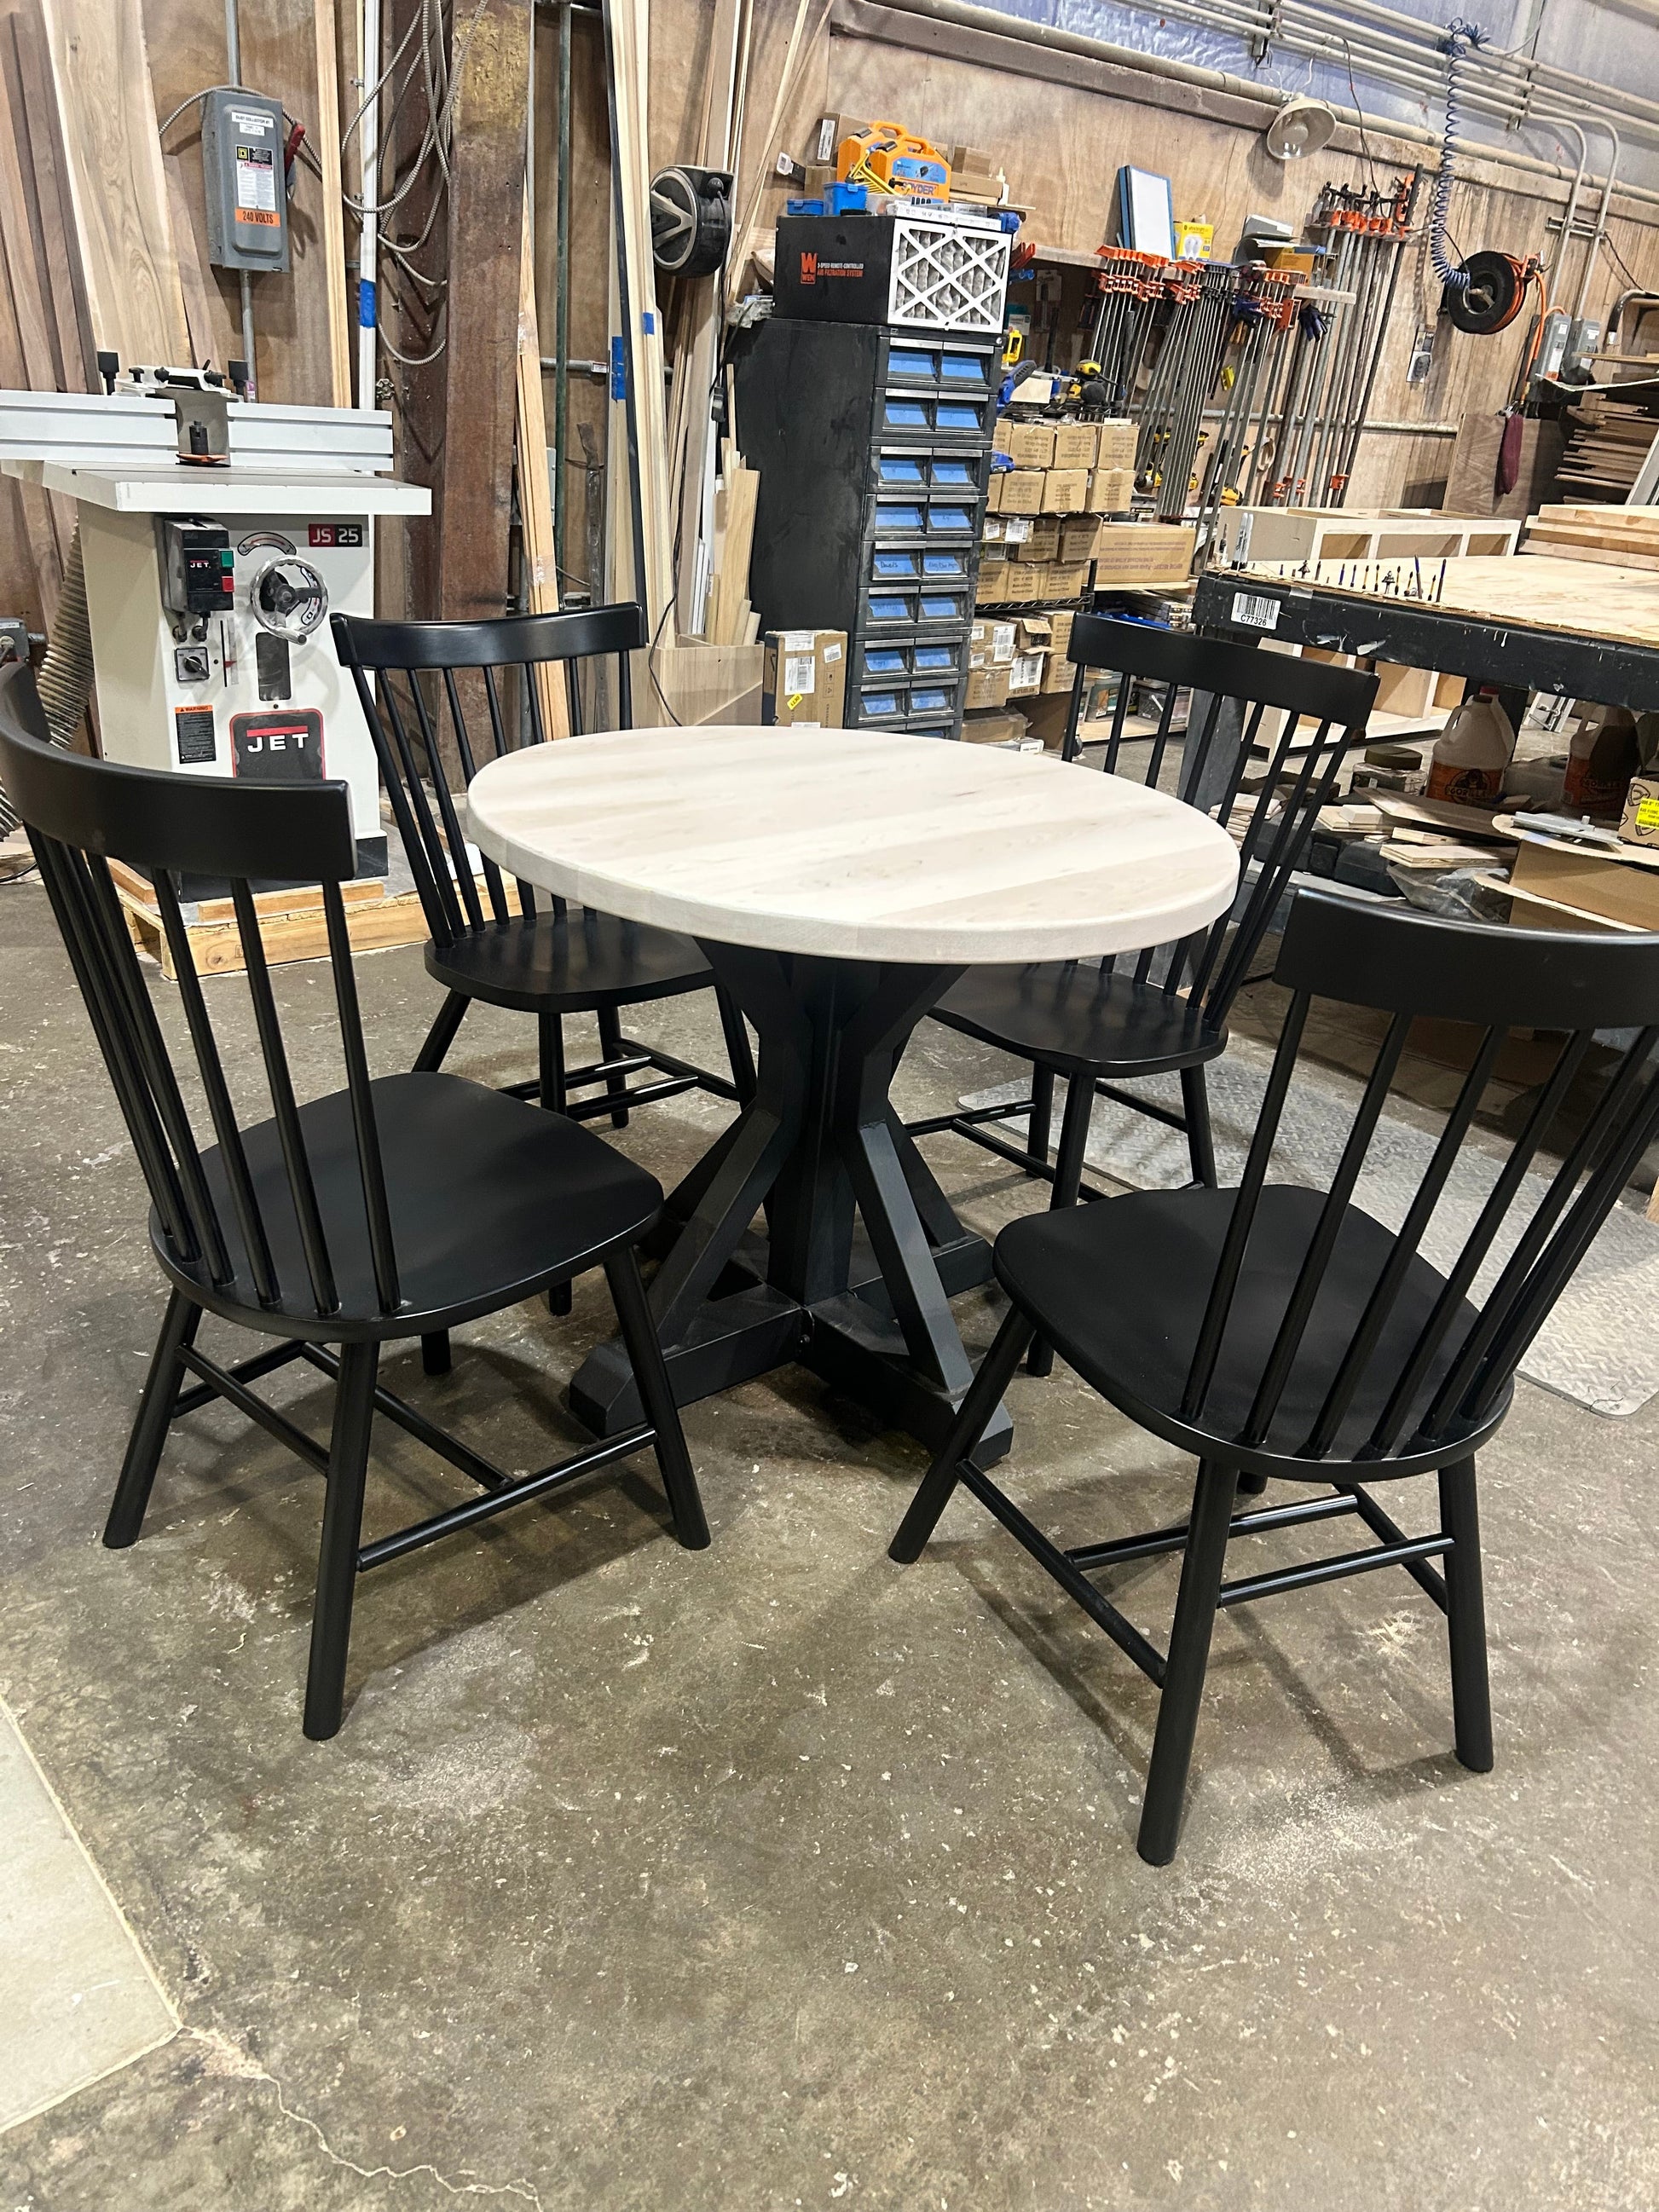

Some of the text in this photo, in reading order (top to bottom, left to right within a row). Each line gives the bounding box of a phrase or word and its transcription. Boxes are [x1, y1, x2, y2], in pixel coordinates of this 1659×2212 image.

[242, 211, 274, 224] 240 VOLTS
[312, 528, 359, 543] JS 25
[1240, 614, 1267, 627] C77326
[247, 733, 309, 753] JET
